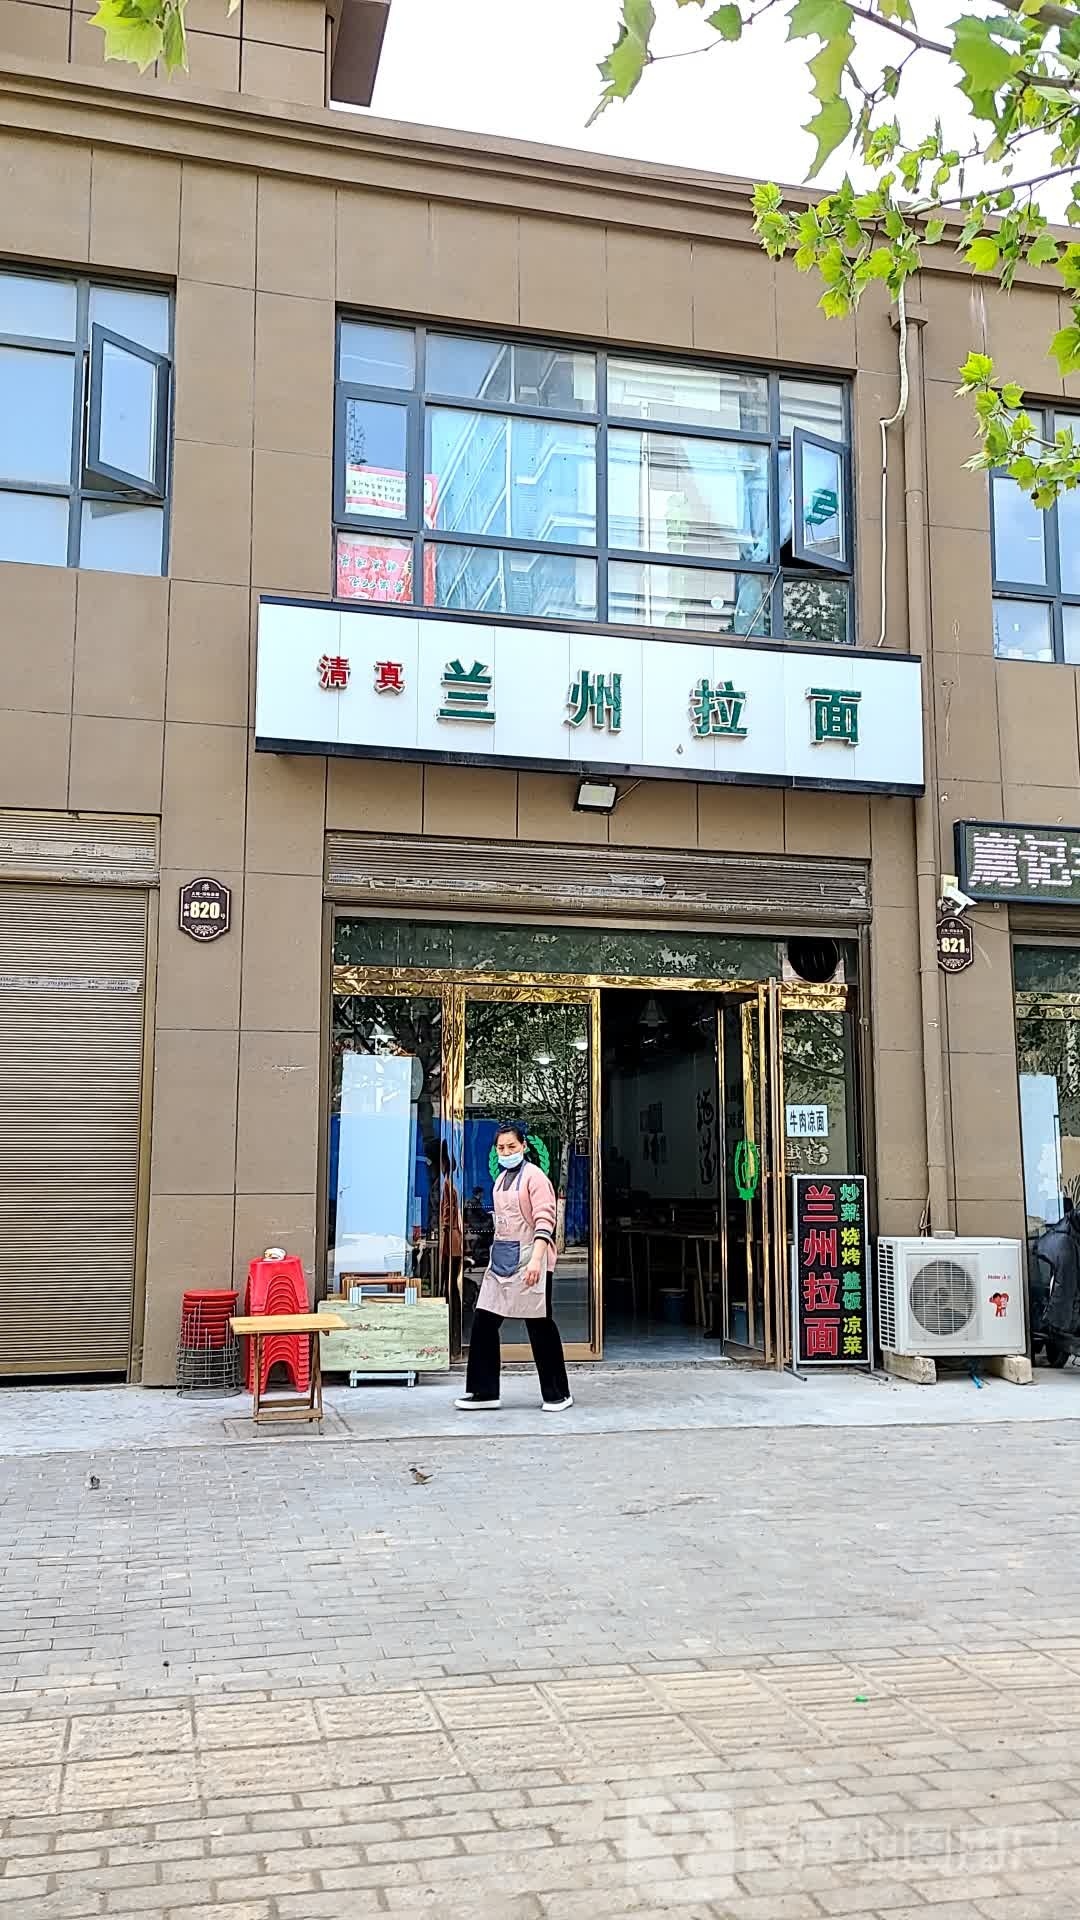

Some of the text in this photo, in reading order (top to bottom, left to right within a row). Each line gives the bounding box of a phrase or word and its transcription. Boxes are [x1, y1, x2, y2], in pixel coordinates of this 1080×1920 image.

[318, 653, 862, 747] 清真 兰州拉面
[789, 1109, 825, 1133] 牛肉凉面
[803, 1184, 840, 1357] 兰州拉面
[839, 1183, 863, 1354] 炒菜 烧烤 盖饭 凉菜
